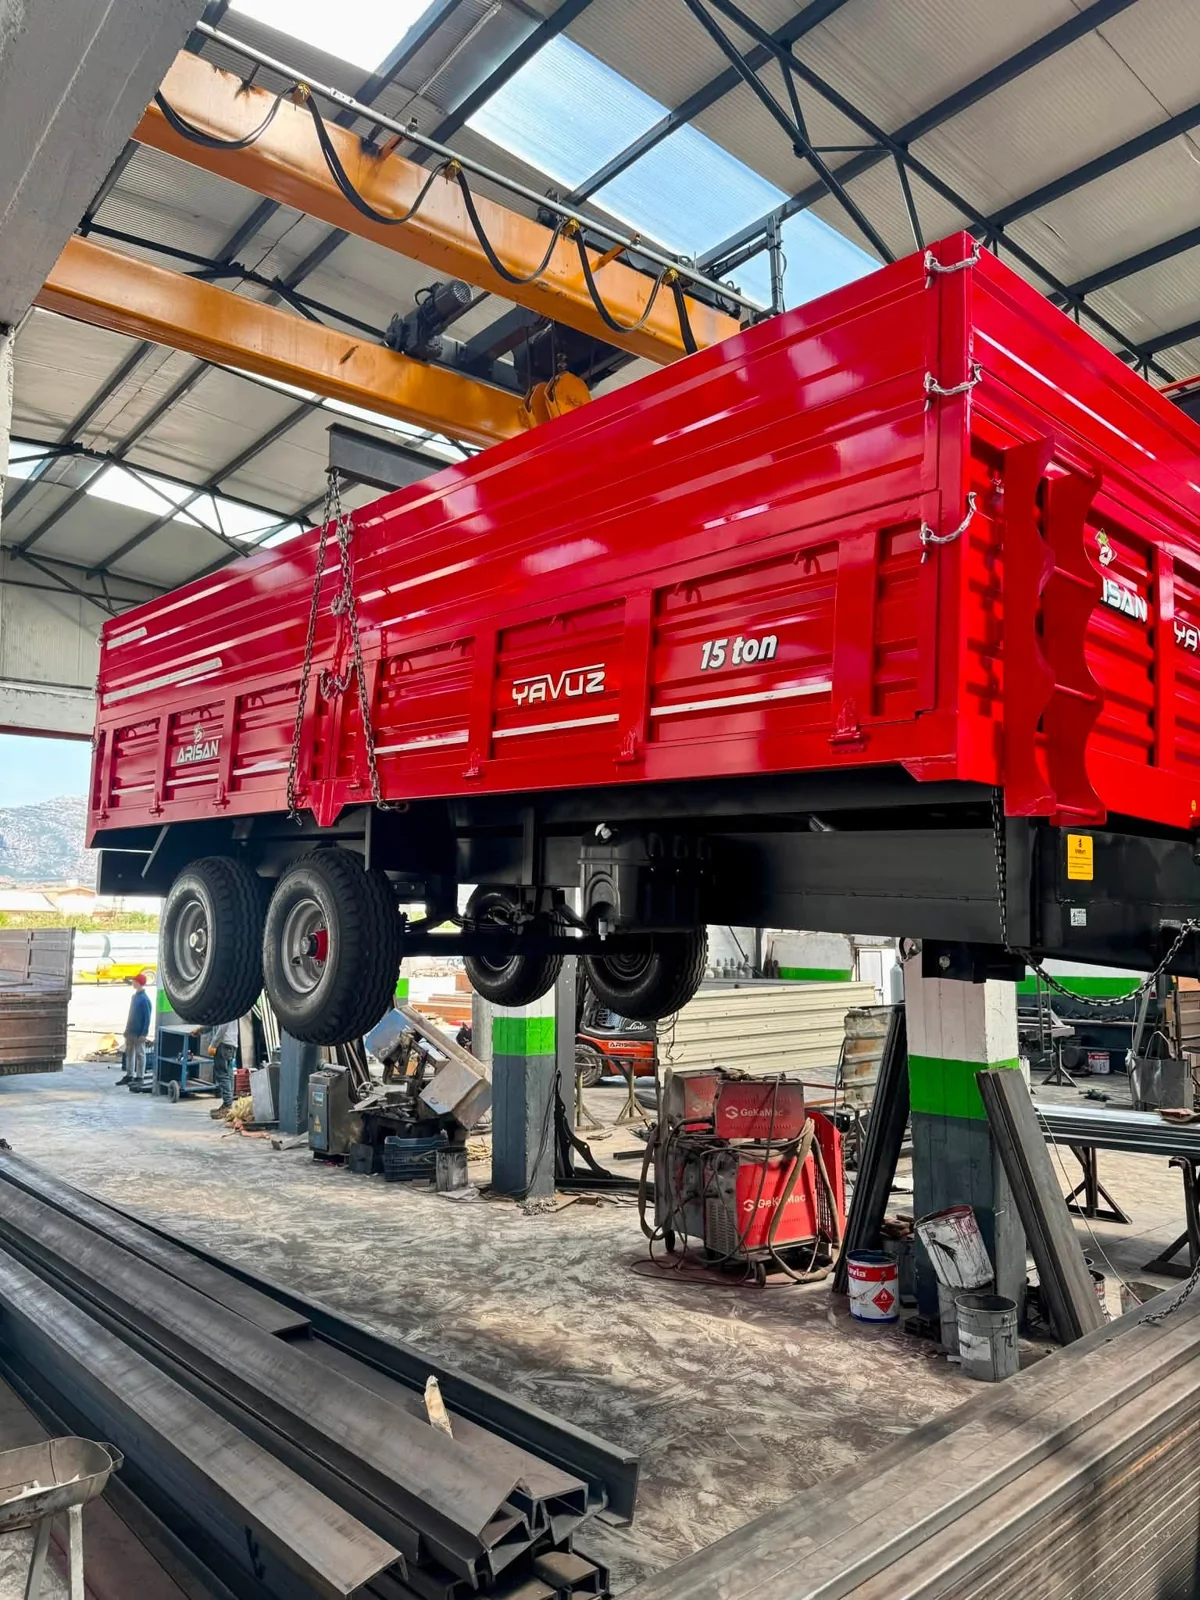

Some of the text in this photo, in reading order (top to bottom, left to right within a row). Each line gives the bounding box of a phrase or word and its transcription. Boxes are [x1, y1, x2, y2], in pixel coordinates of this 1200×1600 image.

[1101, 577, 1148, 622] ISAN
[700, 633, 778, 670] 15 ton
[1173, 615, 1200, 652] YA
[511, 663, 606, 706] YAVUZ
[176, 739, 219, 764] ARISAN
[757, 1194, 806, 1209] GeKMac
